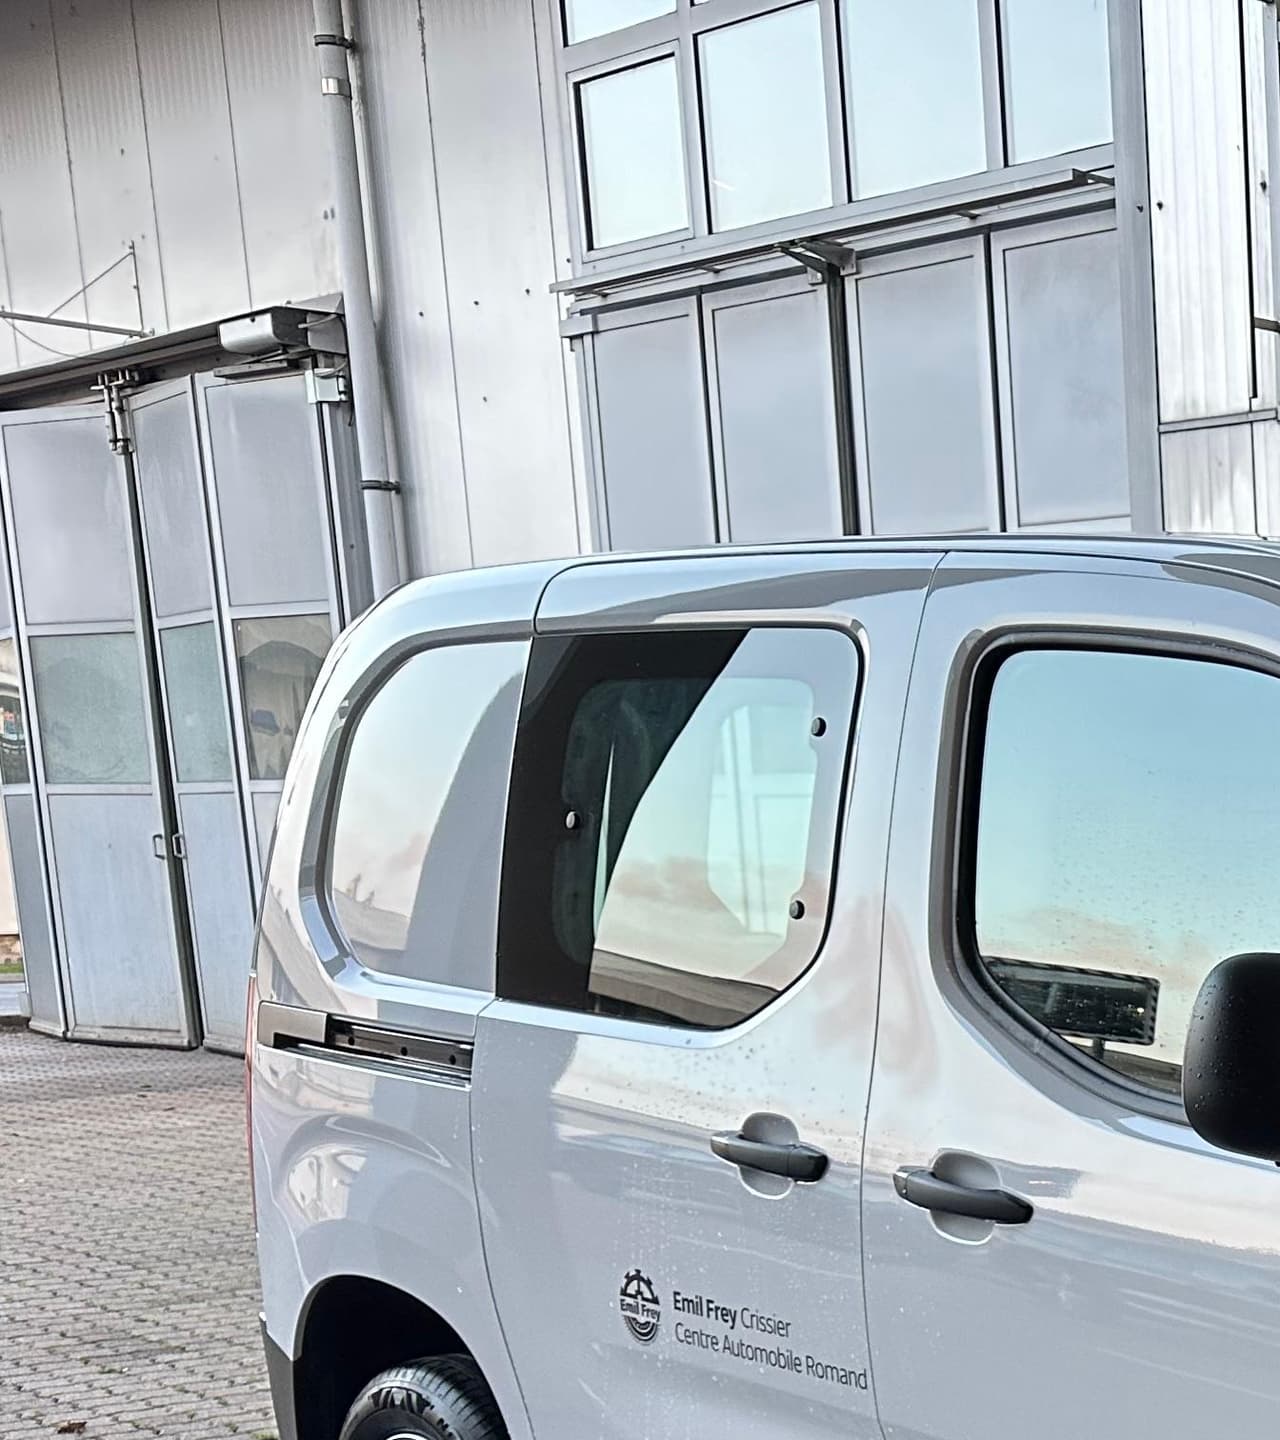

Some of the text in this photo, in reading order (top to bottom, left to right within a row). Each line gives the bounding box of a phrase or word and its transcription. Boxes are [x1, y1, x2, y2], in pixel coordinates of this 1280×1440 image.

[620, 1298, 661, 1323] Emil Frey
[673, 1291, 792, 1338] Emil Frey Crissier
[675, 1322, 868, 1390] Centre Automobile Romand
